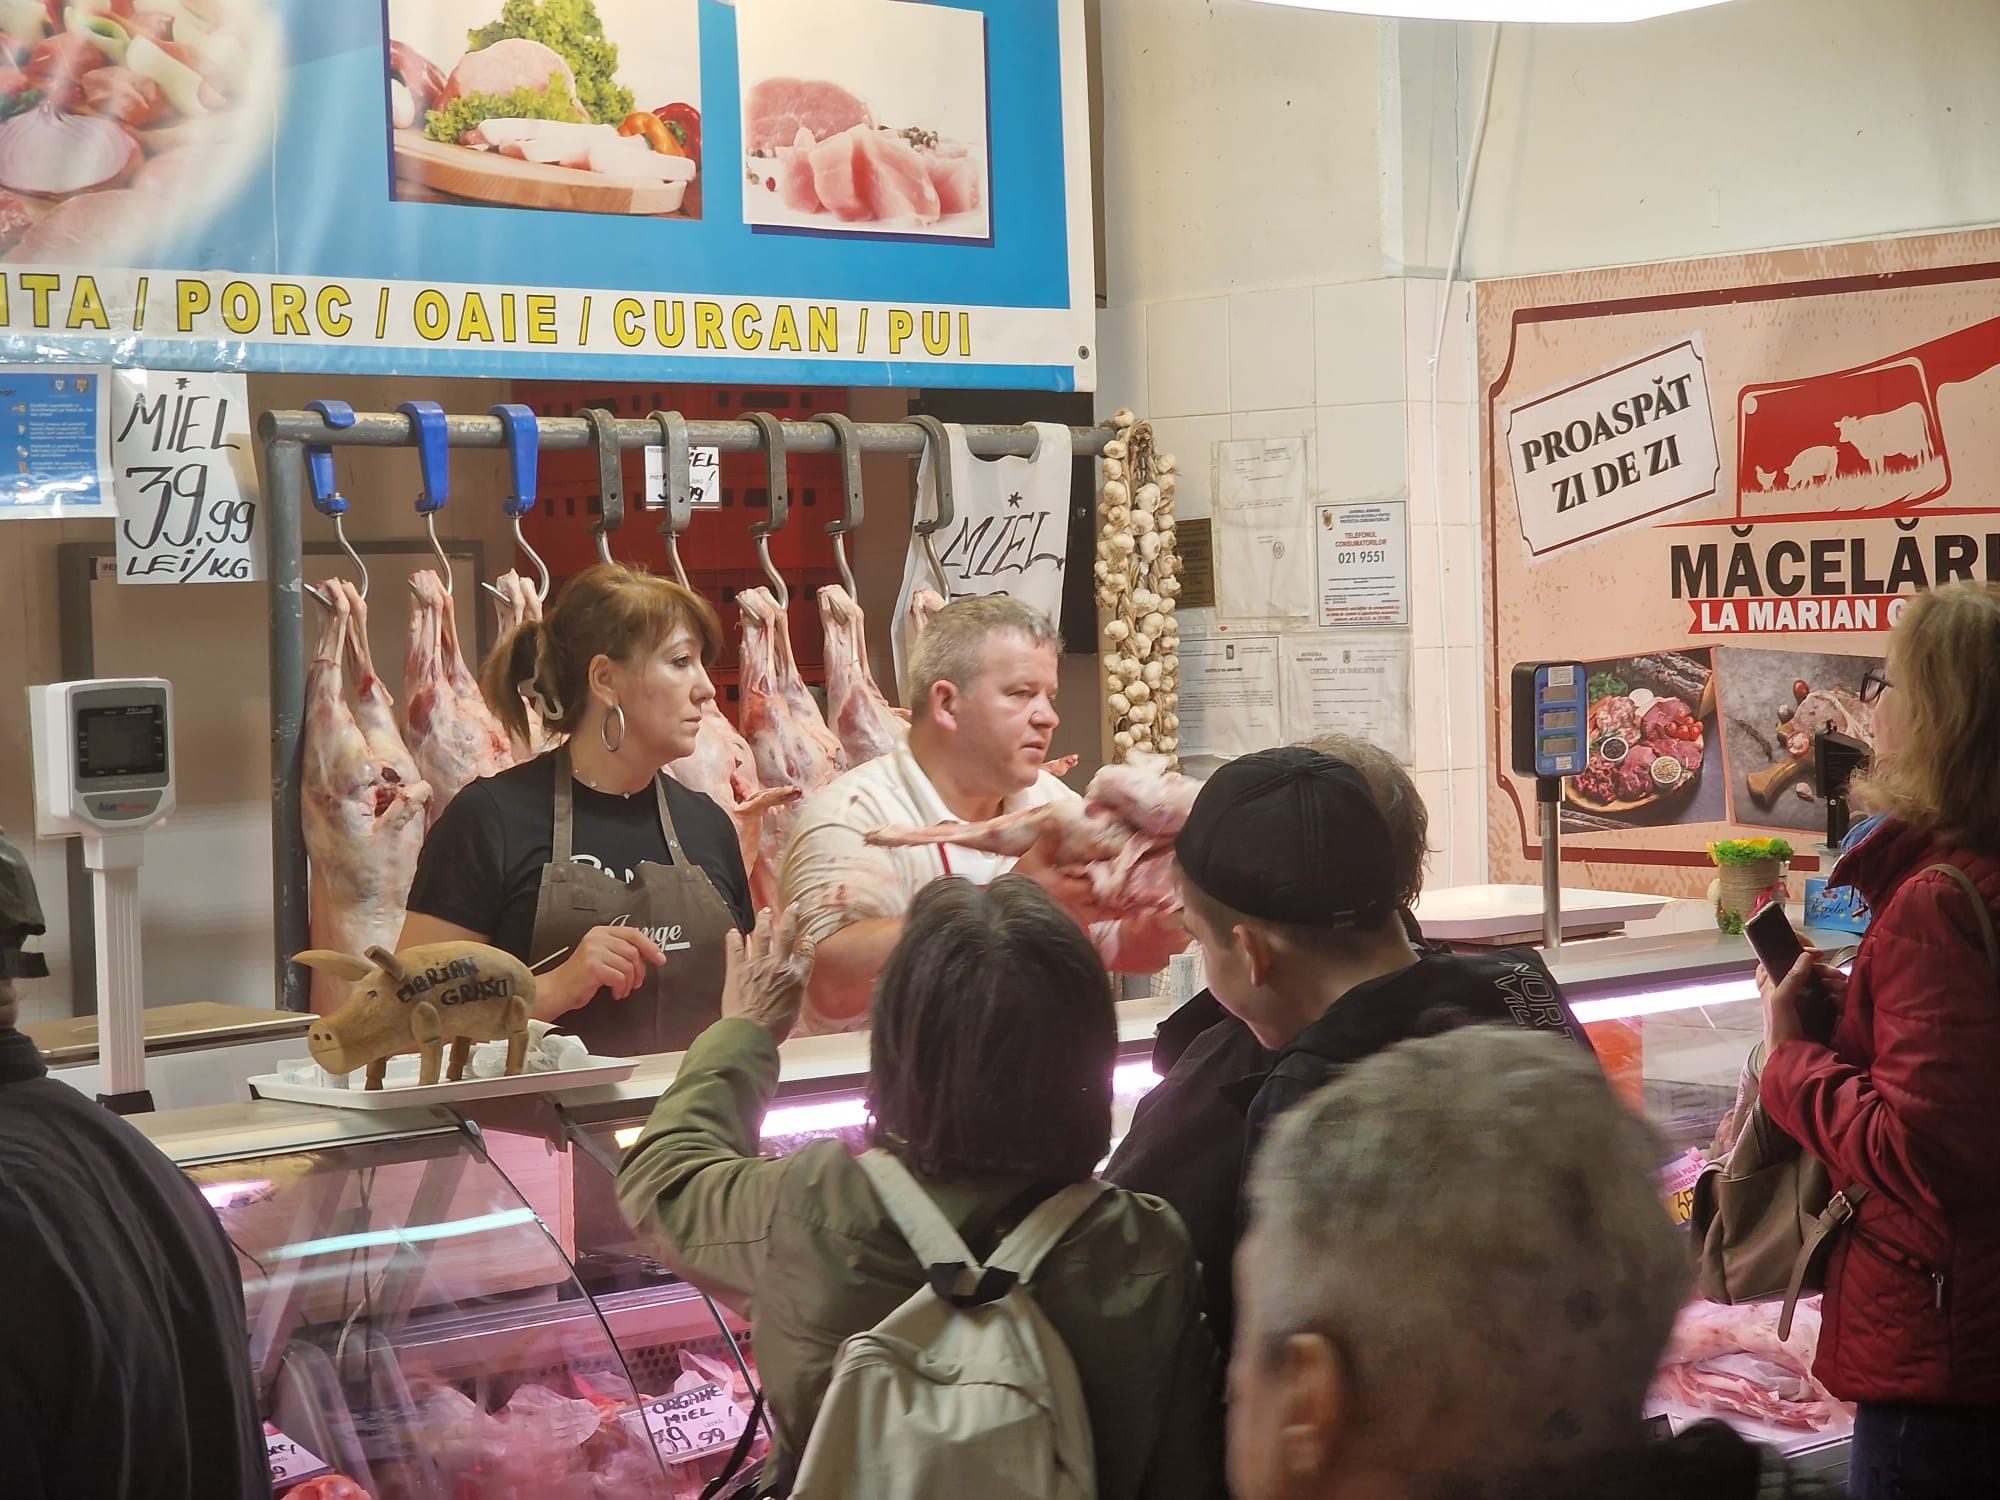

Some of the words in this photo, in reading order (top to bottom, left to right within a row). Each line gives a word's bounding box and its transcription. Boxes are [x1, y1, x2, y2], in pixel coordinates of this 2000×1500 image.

[176, 279, 353, 337] PORC
[413, 289, 559, 345] OAIE
[613, 298, 839, 353] CURCAN
[888, 310, 972, 357] PUI
[1519, 373, 1692, 474] PROASPĂT
[1551, 472, 1589, 513] ZI
[1591, 451, 1641, 498] DE
[1643, 434, 1683, 476] ZI
[1338, 552, 1356, 564] 021
[1360, 550, 1385, 563] 9551
[1701, 602, 1740, 632] LA
[1748, 598, 1877, 631] MARIAN
